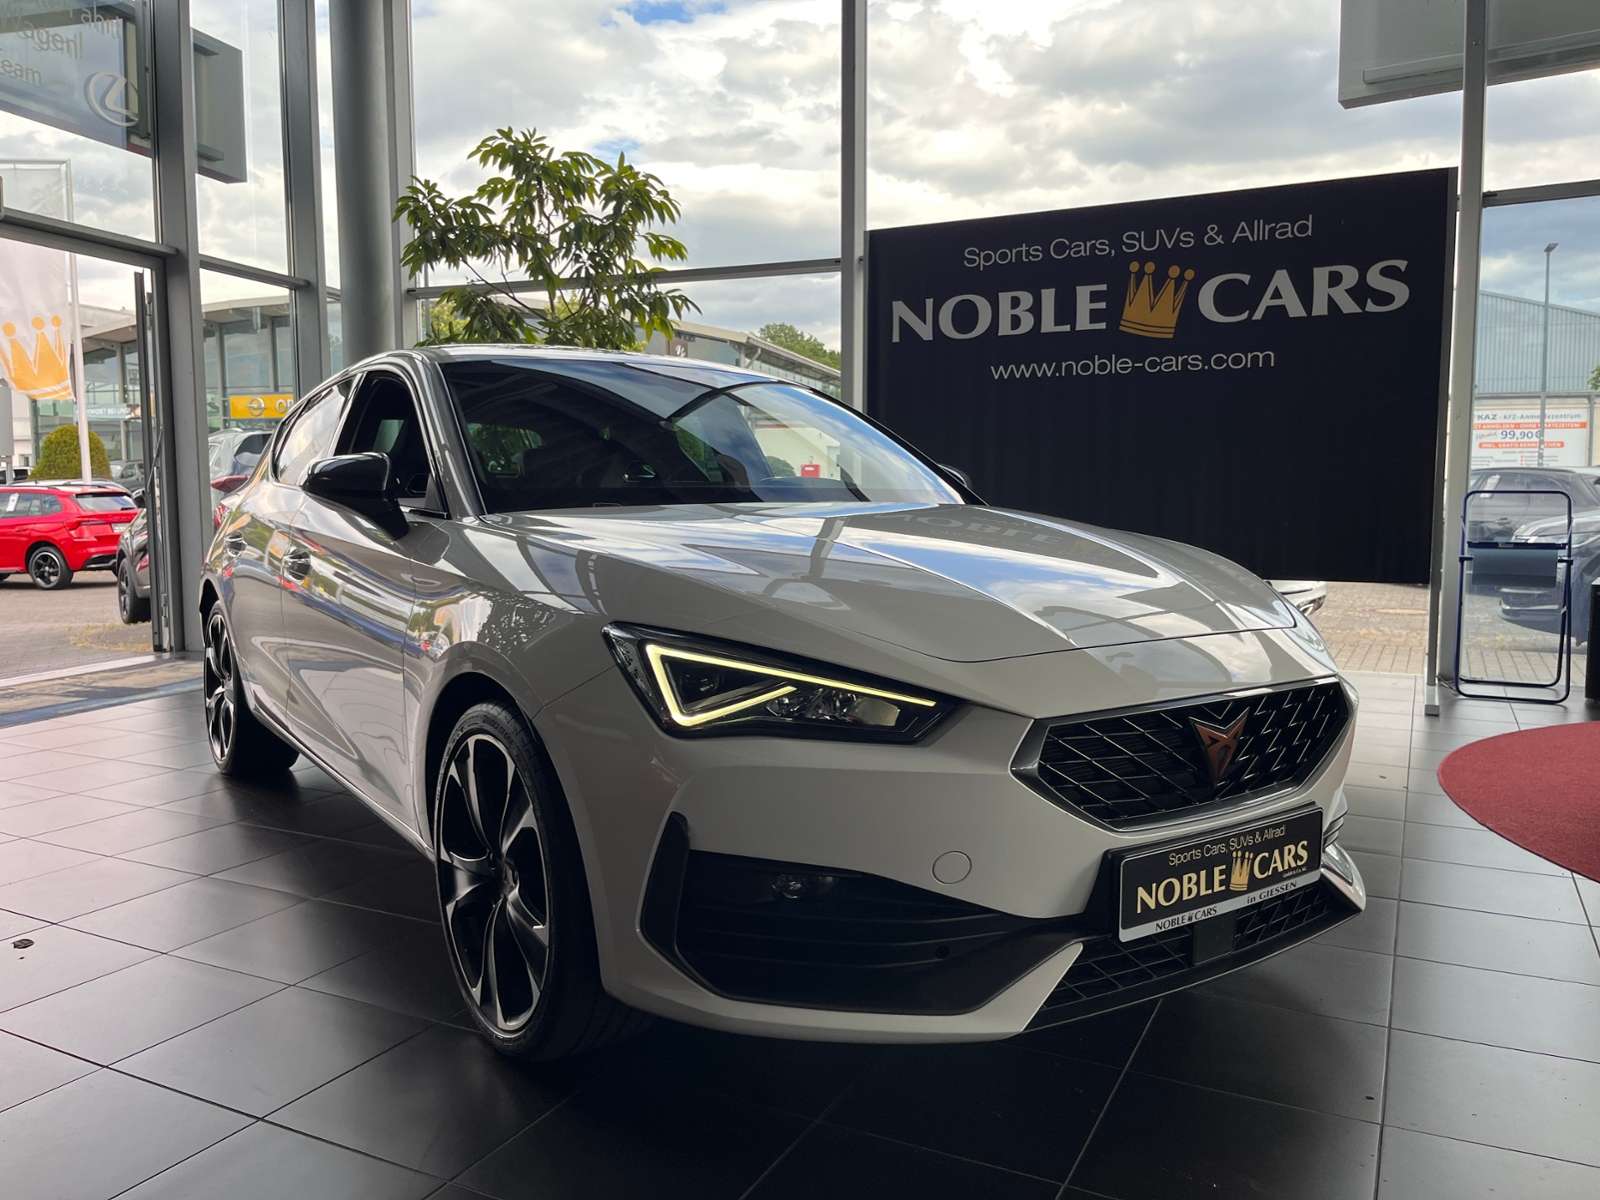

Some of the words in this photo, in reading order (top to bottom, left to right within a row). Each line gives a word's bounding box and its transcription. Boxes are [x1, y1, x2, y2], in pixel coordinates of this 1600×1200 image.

[963, 242, 1042, 271] Sports
[1050, 238, 1116, 260] Cars,
[1121, 227, 1195, 253] SUVs
[1203, 224, 1225, 246] &
[1231, 214, 1313, 243] Allrad
[891, 283, 1108, 343] NOBLE
[1197, 259, 1410, 323] CARS
[990, 350, 1275, 380] www.noble-cars.com
[1168, 850, 1202, 867] Sports
[1203, 843, 1228, 857] Cars,
[1229, 835, 1254, 850] SUVs
[1254, 831, 1262, 843] &
[1262, 825, 1286, 841] Allrad
[1136, 864, 1227, 914] NOBLE
[1253, 840, 1308, 879] CARS
[1155, 914, 1187, 932] NOBLE
[1193, 905, 1218, 922] CARS
[1247, 895, 1256, 904] in
[1259, 880, 1297, 900] GIESSEN
